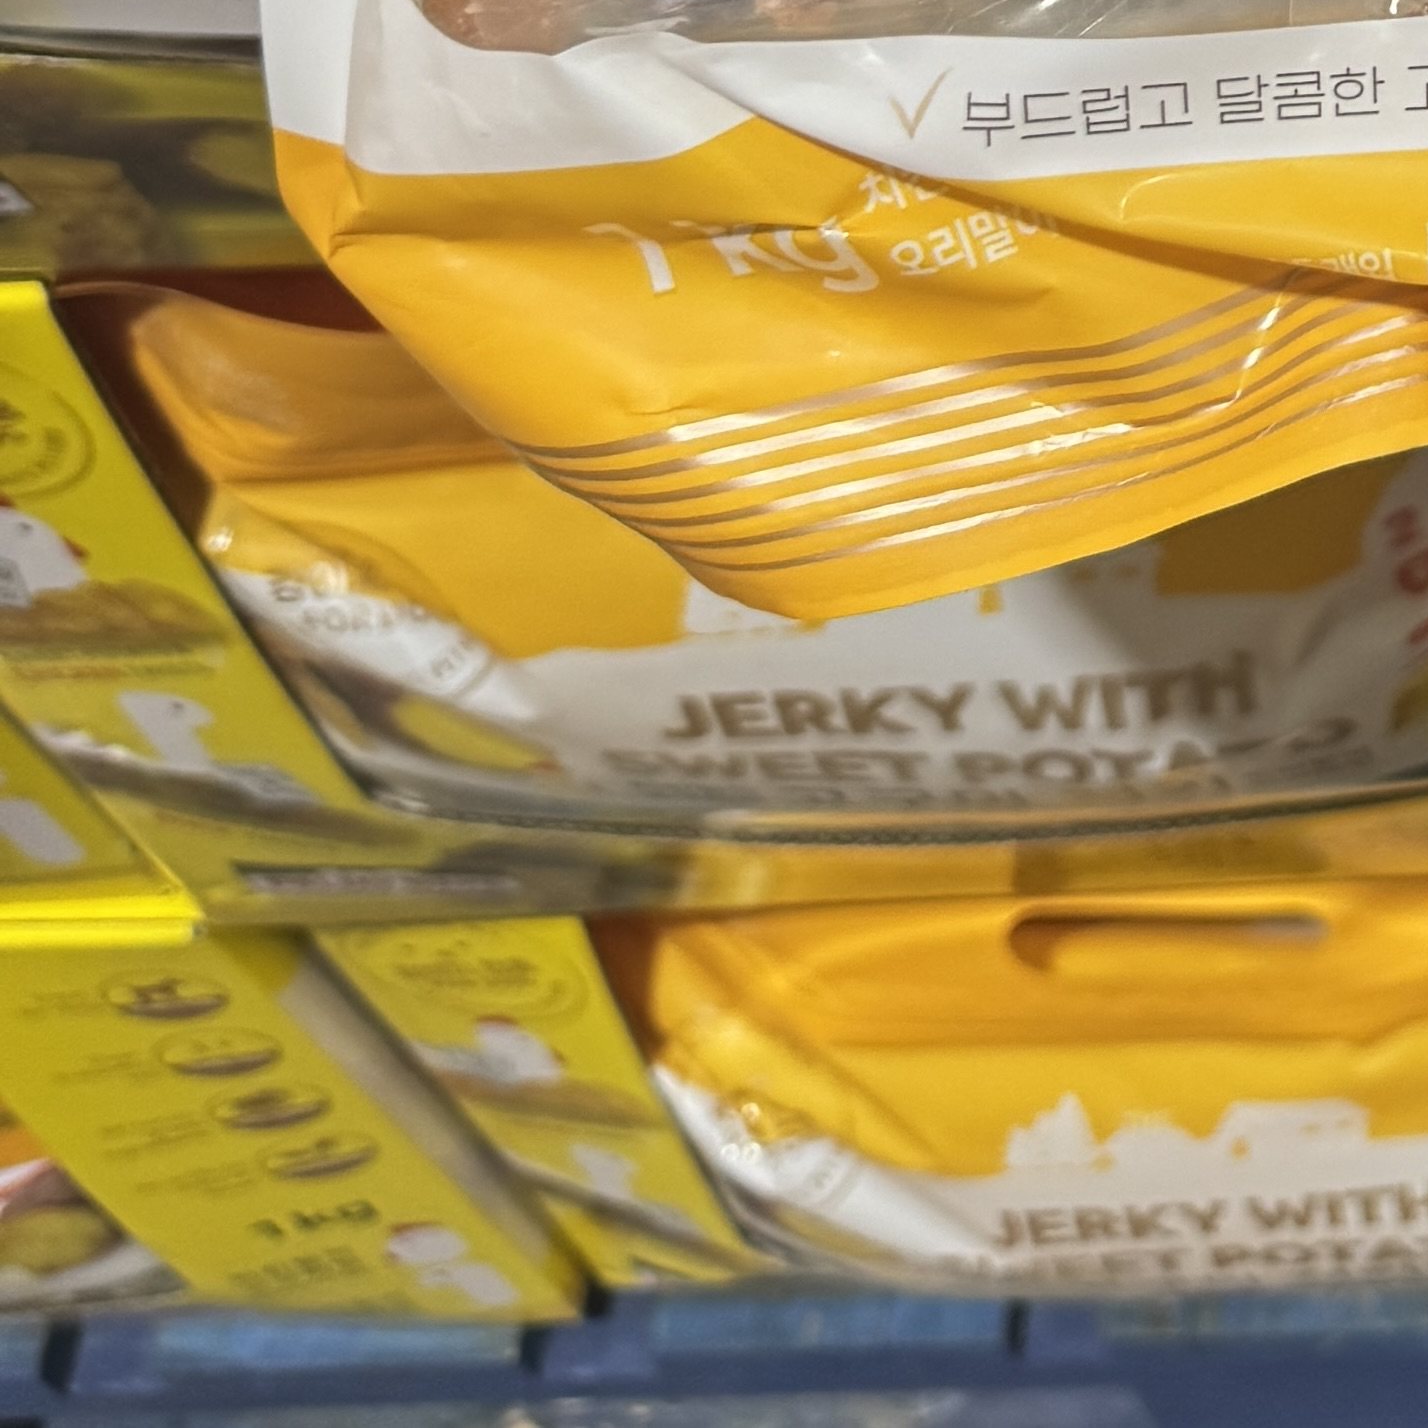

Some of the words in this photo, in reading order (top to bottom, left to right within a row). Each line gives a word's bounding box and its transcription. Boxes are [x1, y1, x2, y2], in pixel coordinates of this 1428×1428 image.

[960, 77, 1194, 148] 부드럽고
[1213, 63, 1386, 124] 달콤한
[661, 682, 976, 741] JERKY
[995, 650, 1261, 734] WITH
[996, 1197, 1225, 1247] JERKY
